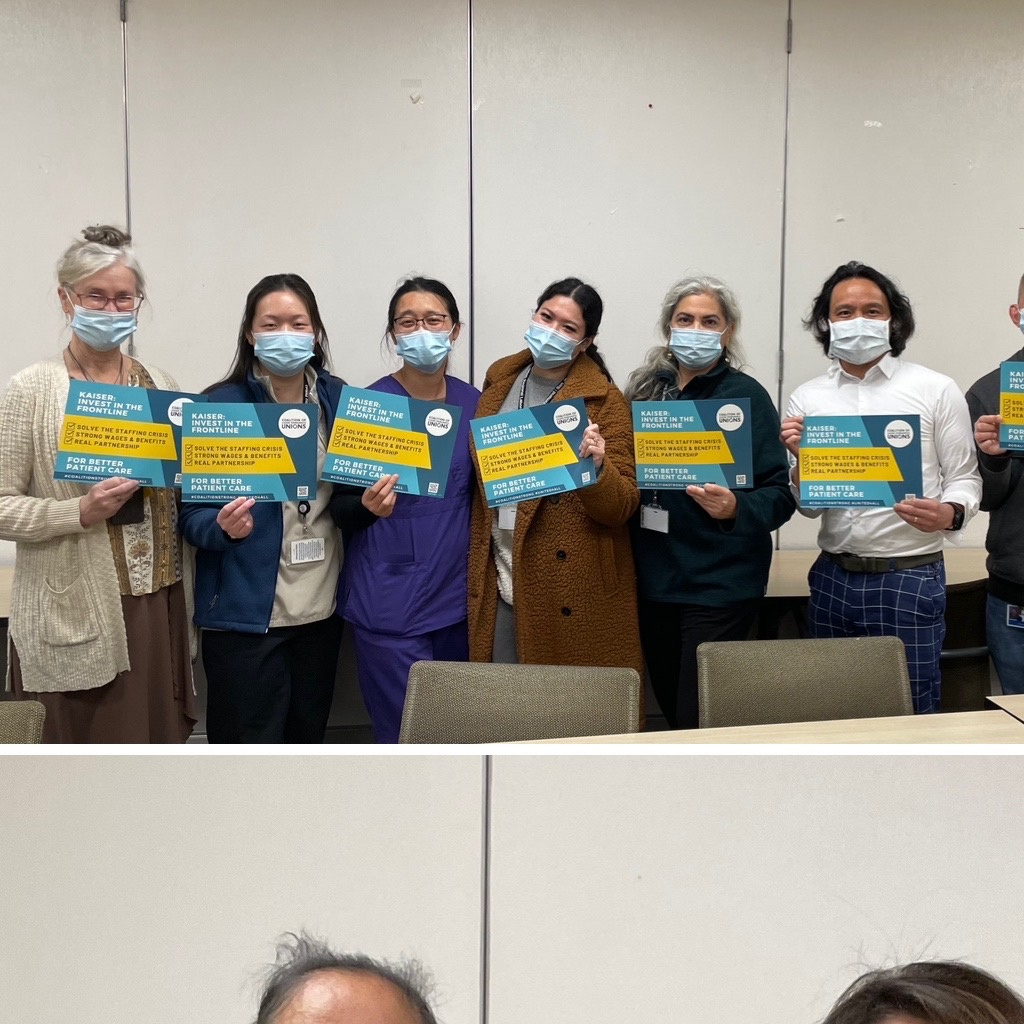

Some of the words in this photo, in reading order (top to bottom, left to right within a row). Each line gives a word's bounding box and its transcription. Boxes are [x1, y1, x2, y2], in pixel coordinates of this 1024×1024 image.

[78, 398, 112, 407] INVEST
[76, 405, 128, 415] FRONTLINE
[346, 410, 390, 422] FRONTLINE
[557, 416, 577, 424] UNIONS
[481, 428, 508, 438] INVEST
[395, 444, 422, 452] BENEFITS
[493, 484, 524, 496] PATIENT
[525, 480, 545, 488] CARE
